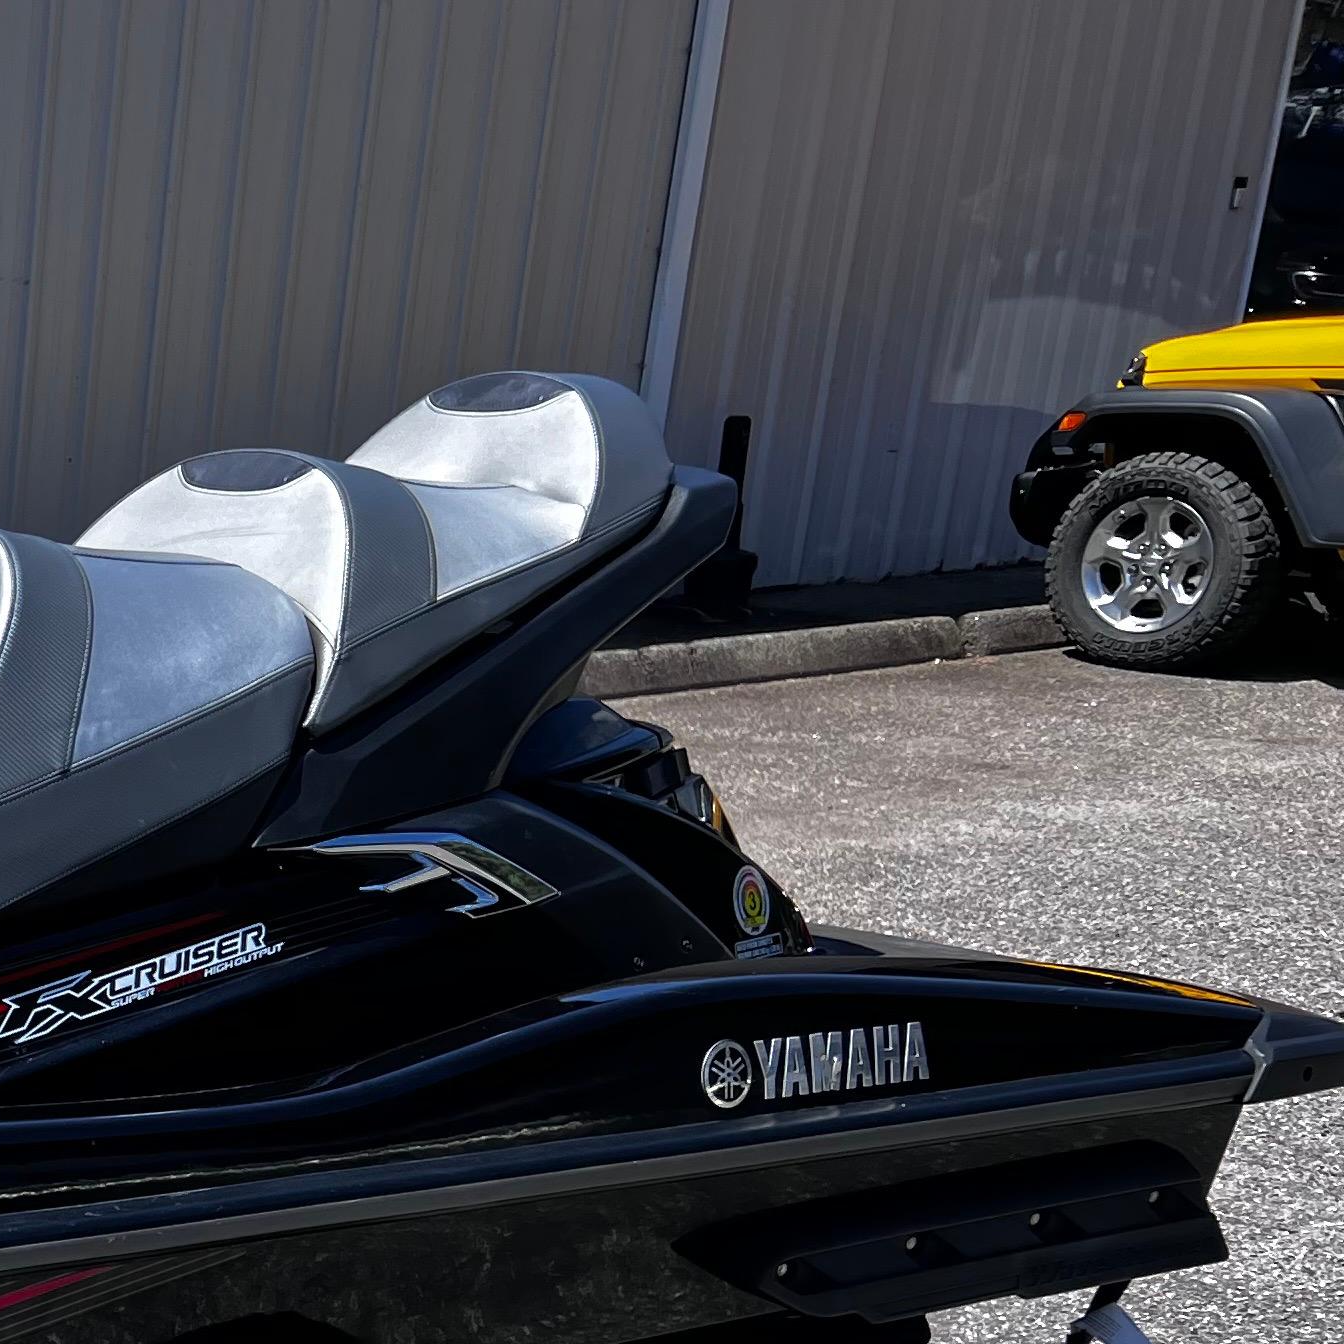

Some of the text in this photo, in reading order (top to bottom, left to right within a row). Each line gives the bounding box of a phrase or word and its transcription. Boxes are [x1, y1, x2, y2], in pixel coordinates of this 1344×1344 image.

[107, 921, 268, 1000] CRUISER
[110, 986, 157, 1010] SUPER
[753, 1021, 930, 1100] YAMAHA
